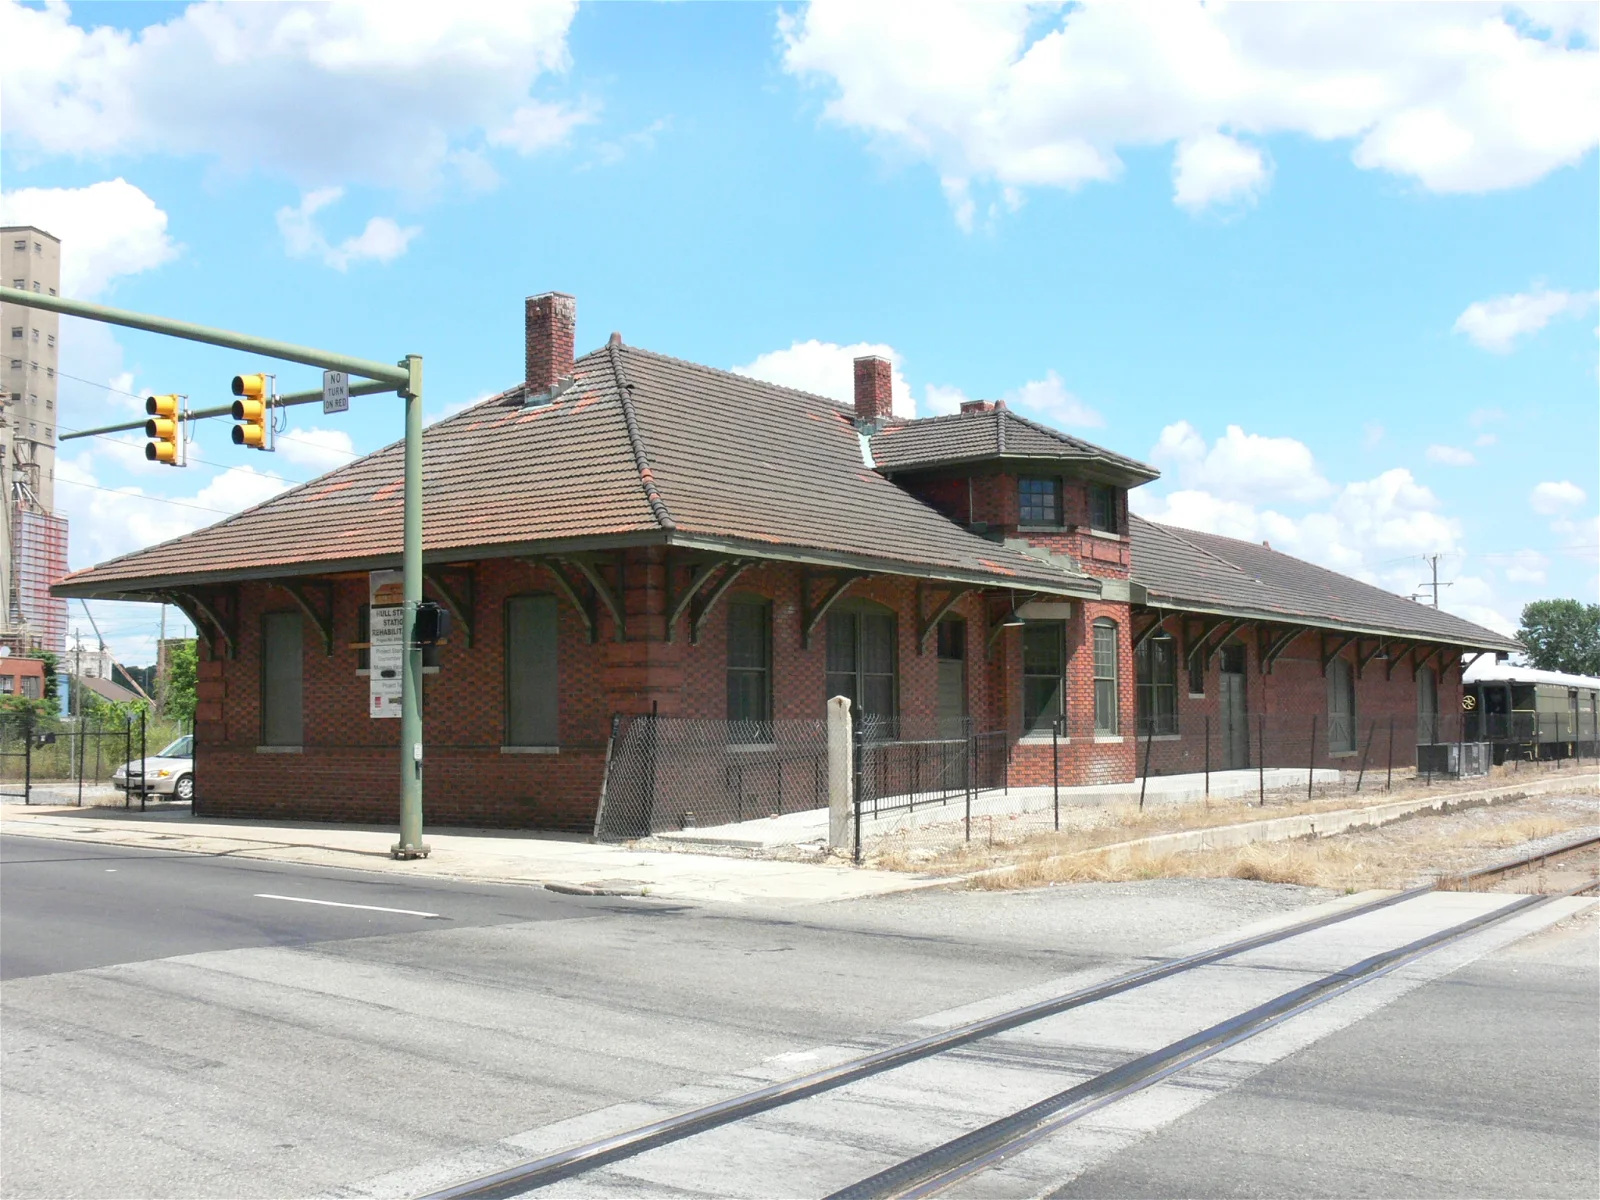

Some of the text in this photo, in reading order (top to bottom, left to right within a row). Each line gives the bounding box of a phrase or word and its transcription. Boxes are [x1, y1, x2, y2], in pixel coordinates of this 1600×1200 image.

[330, 373, 341, 384] NO
[328, 386, 344, 396] TURN
[326, 398, 346, 409] ON RED
[383, 618, 403, 626] STATIO
[372, 627, 403, 636] REHABILIT
